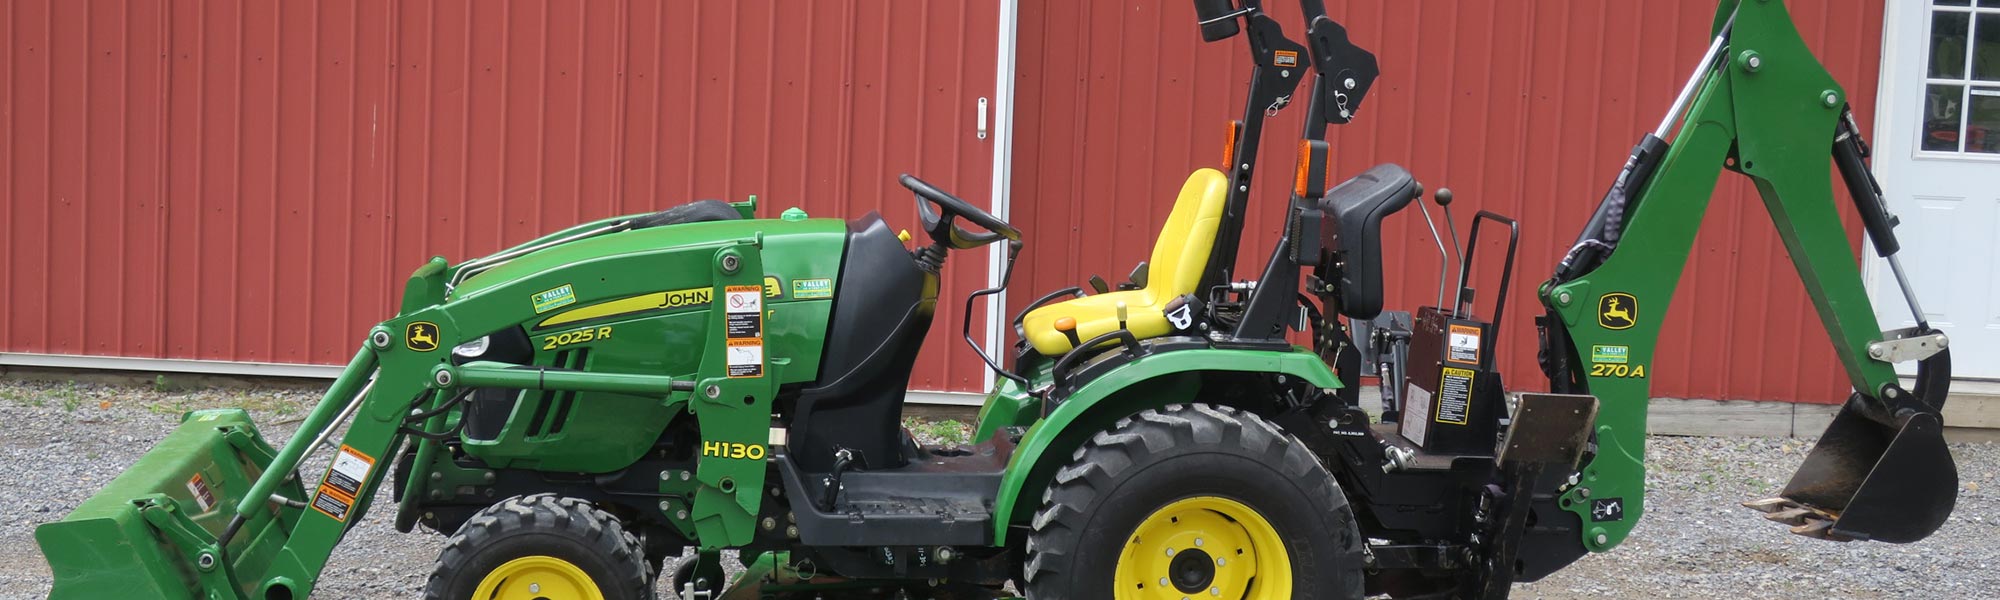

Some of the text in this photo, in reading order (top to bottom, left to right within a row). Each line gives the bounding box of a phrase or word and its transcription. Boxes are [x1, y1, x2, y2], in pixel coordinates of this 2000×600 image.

[542, 287, 570, 299] VALLEY
[658, 290, 709, 307] JOHN
[543, 326, 613, 351] 2025 R
[1451, 369, 1473, 377] CAUTION
[1590, 363, 1645, 378] 270 A
[703, 440, 765, 460] H130
